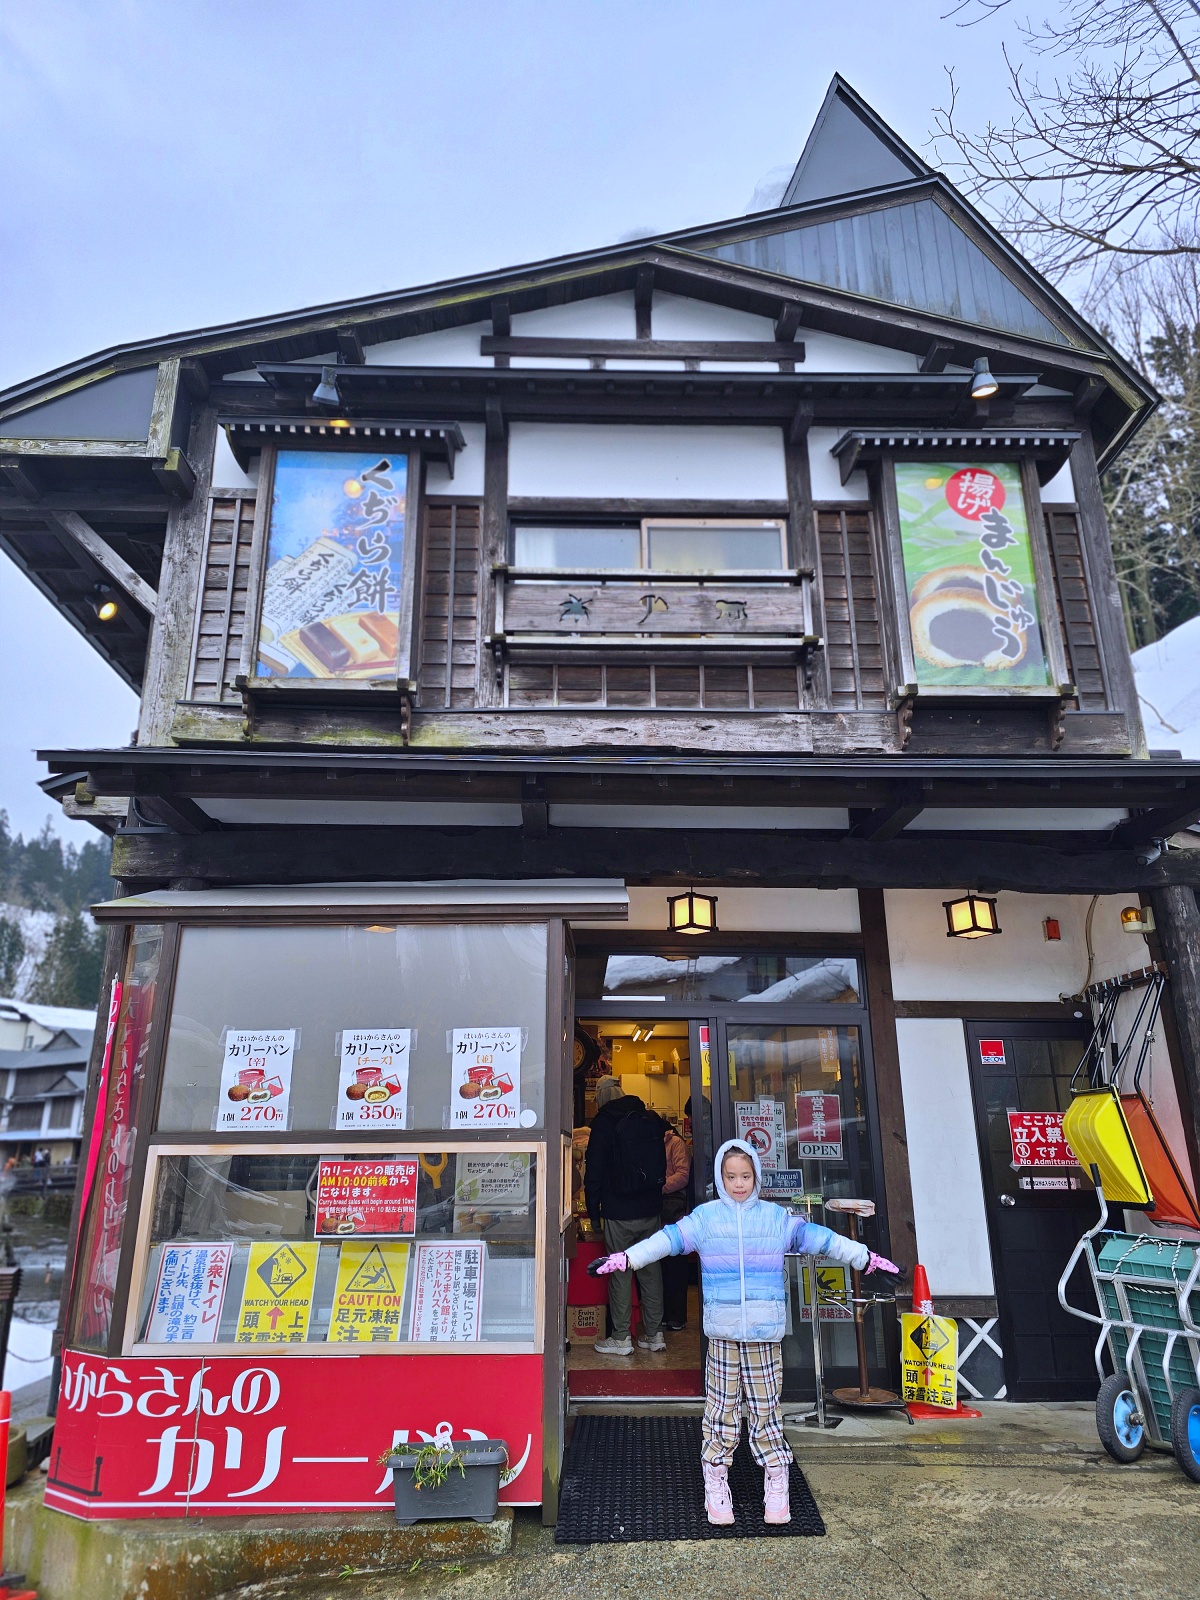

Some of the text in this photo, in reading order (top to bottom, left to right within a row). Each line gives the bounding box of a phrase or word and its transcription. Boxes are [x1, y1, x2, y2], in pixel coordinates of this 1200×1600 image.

[957, 472, 996, 515] 揚げ
[347, 458, 398, 615] くぢら餅
[979, 506, 1035, 660] まんじゅう
[228, 1044, 291, 1057] カリーパン
[345, 1043, 406, 1056] カリーパン
[455, 1041, 517, 1054] カリーパン
[357, 1056, 393, 1065] 【チーズ】
[811, 1096, 826, 1141] 営業中
[1022, 1115, 1063, 1126] ここから
[1013, 1127, 1069, 1143] 立入禁
[802, 1144, 838, 1155] OPEN
[1036, 1147, 1058, 1158] です
[321, 1165, 416, 1176] カリーパンの販売は
[319, 1187, 376, 1198] になります。
[201, 1249, 227, 1324] 公衆トイレ
[440, 1249, 454, 1334] 大正ろまん館より
[338, 1294, 402, 1306] CAUTION
[462, 1249, 479, 1341] 駐車場について
[163, 1294, 185, 1343] 白銀の滝の手
[242, 1311, 304, 1329] 頭 上
[335, 1308, 400, 1325] 足元凍結
[904, 1359, 923, 1367] WATCH
[923, 1360, 937, 1368] YOUR
[905, 1369, 952, 1388] 頭 上
[904, 1386, 954, 1406] 落雪注意
